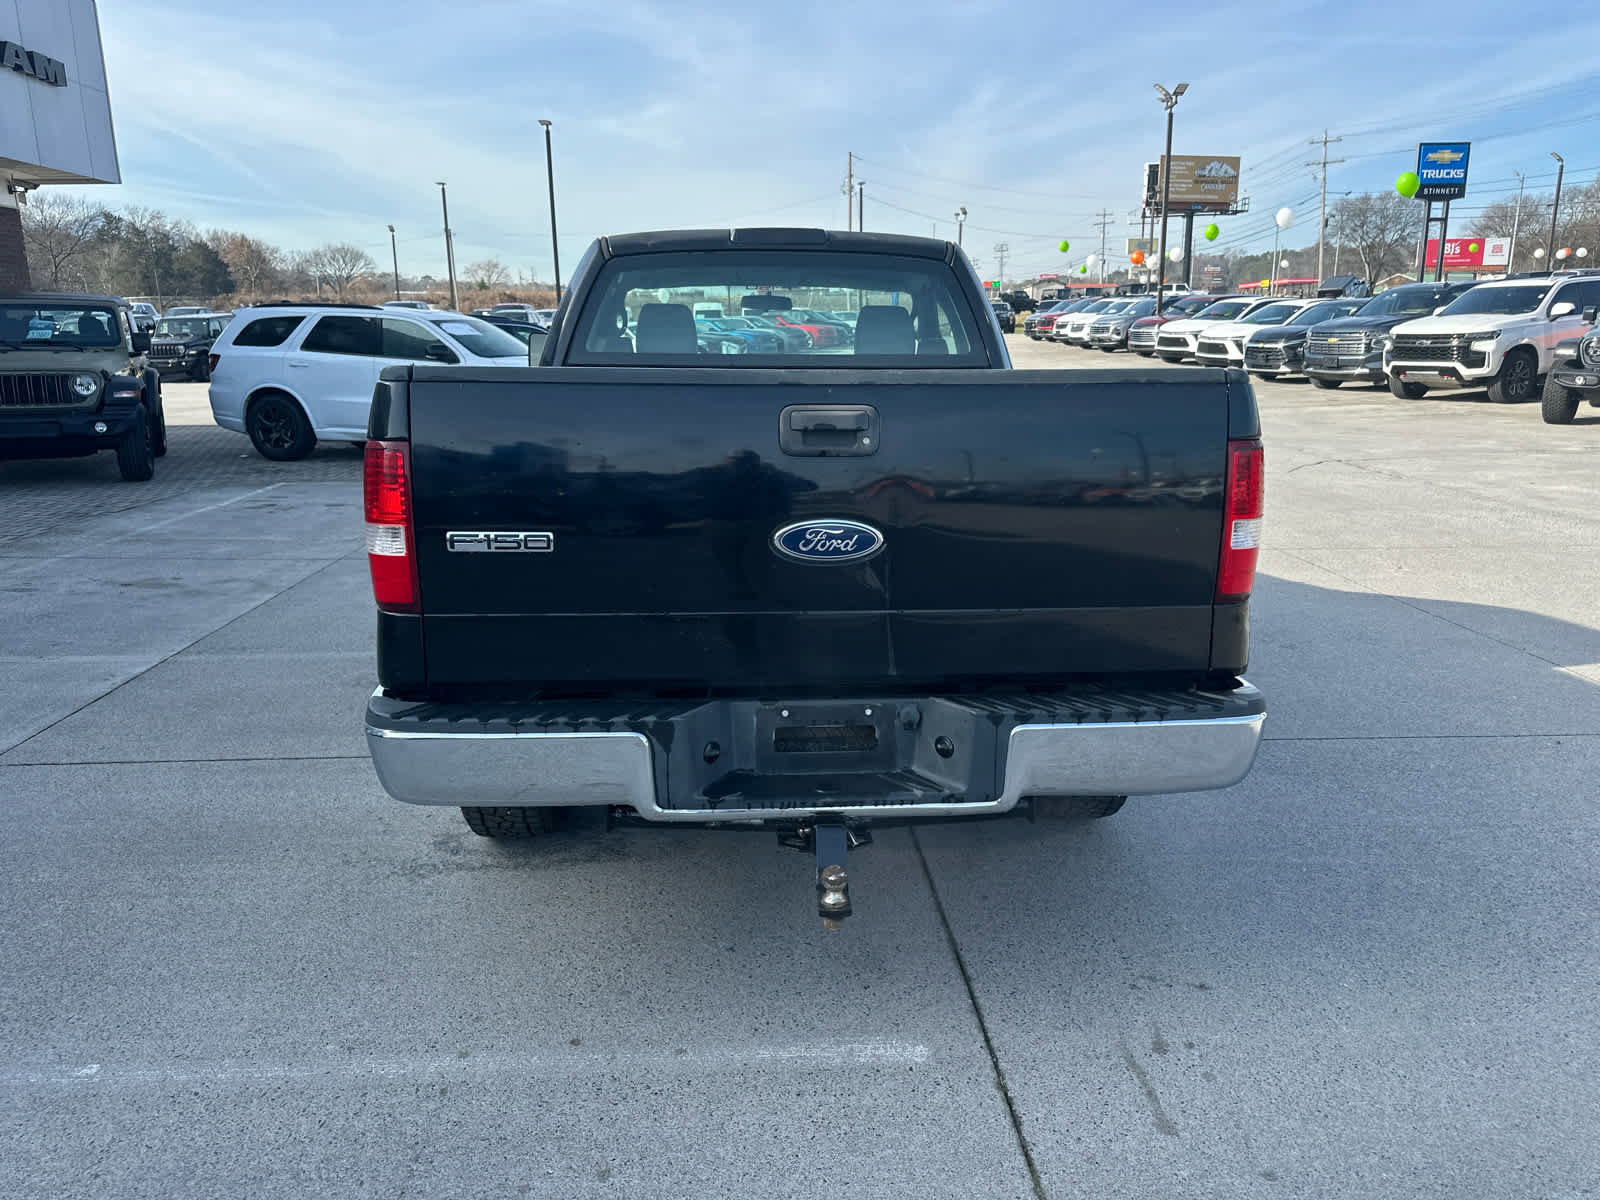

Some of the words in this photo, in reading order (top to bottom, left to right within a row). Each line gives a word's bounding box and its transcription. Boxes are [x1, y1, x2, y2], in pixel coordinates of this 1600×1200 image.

[1422, 169, 1465, 179] TRUCKS
[1423, 187, 1459, 195] STINNETT
[798, 528, 859, 552] Ford
